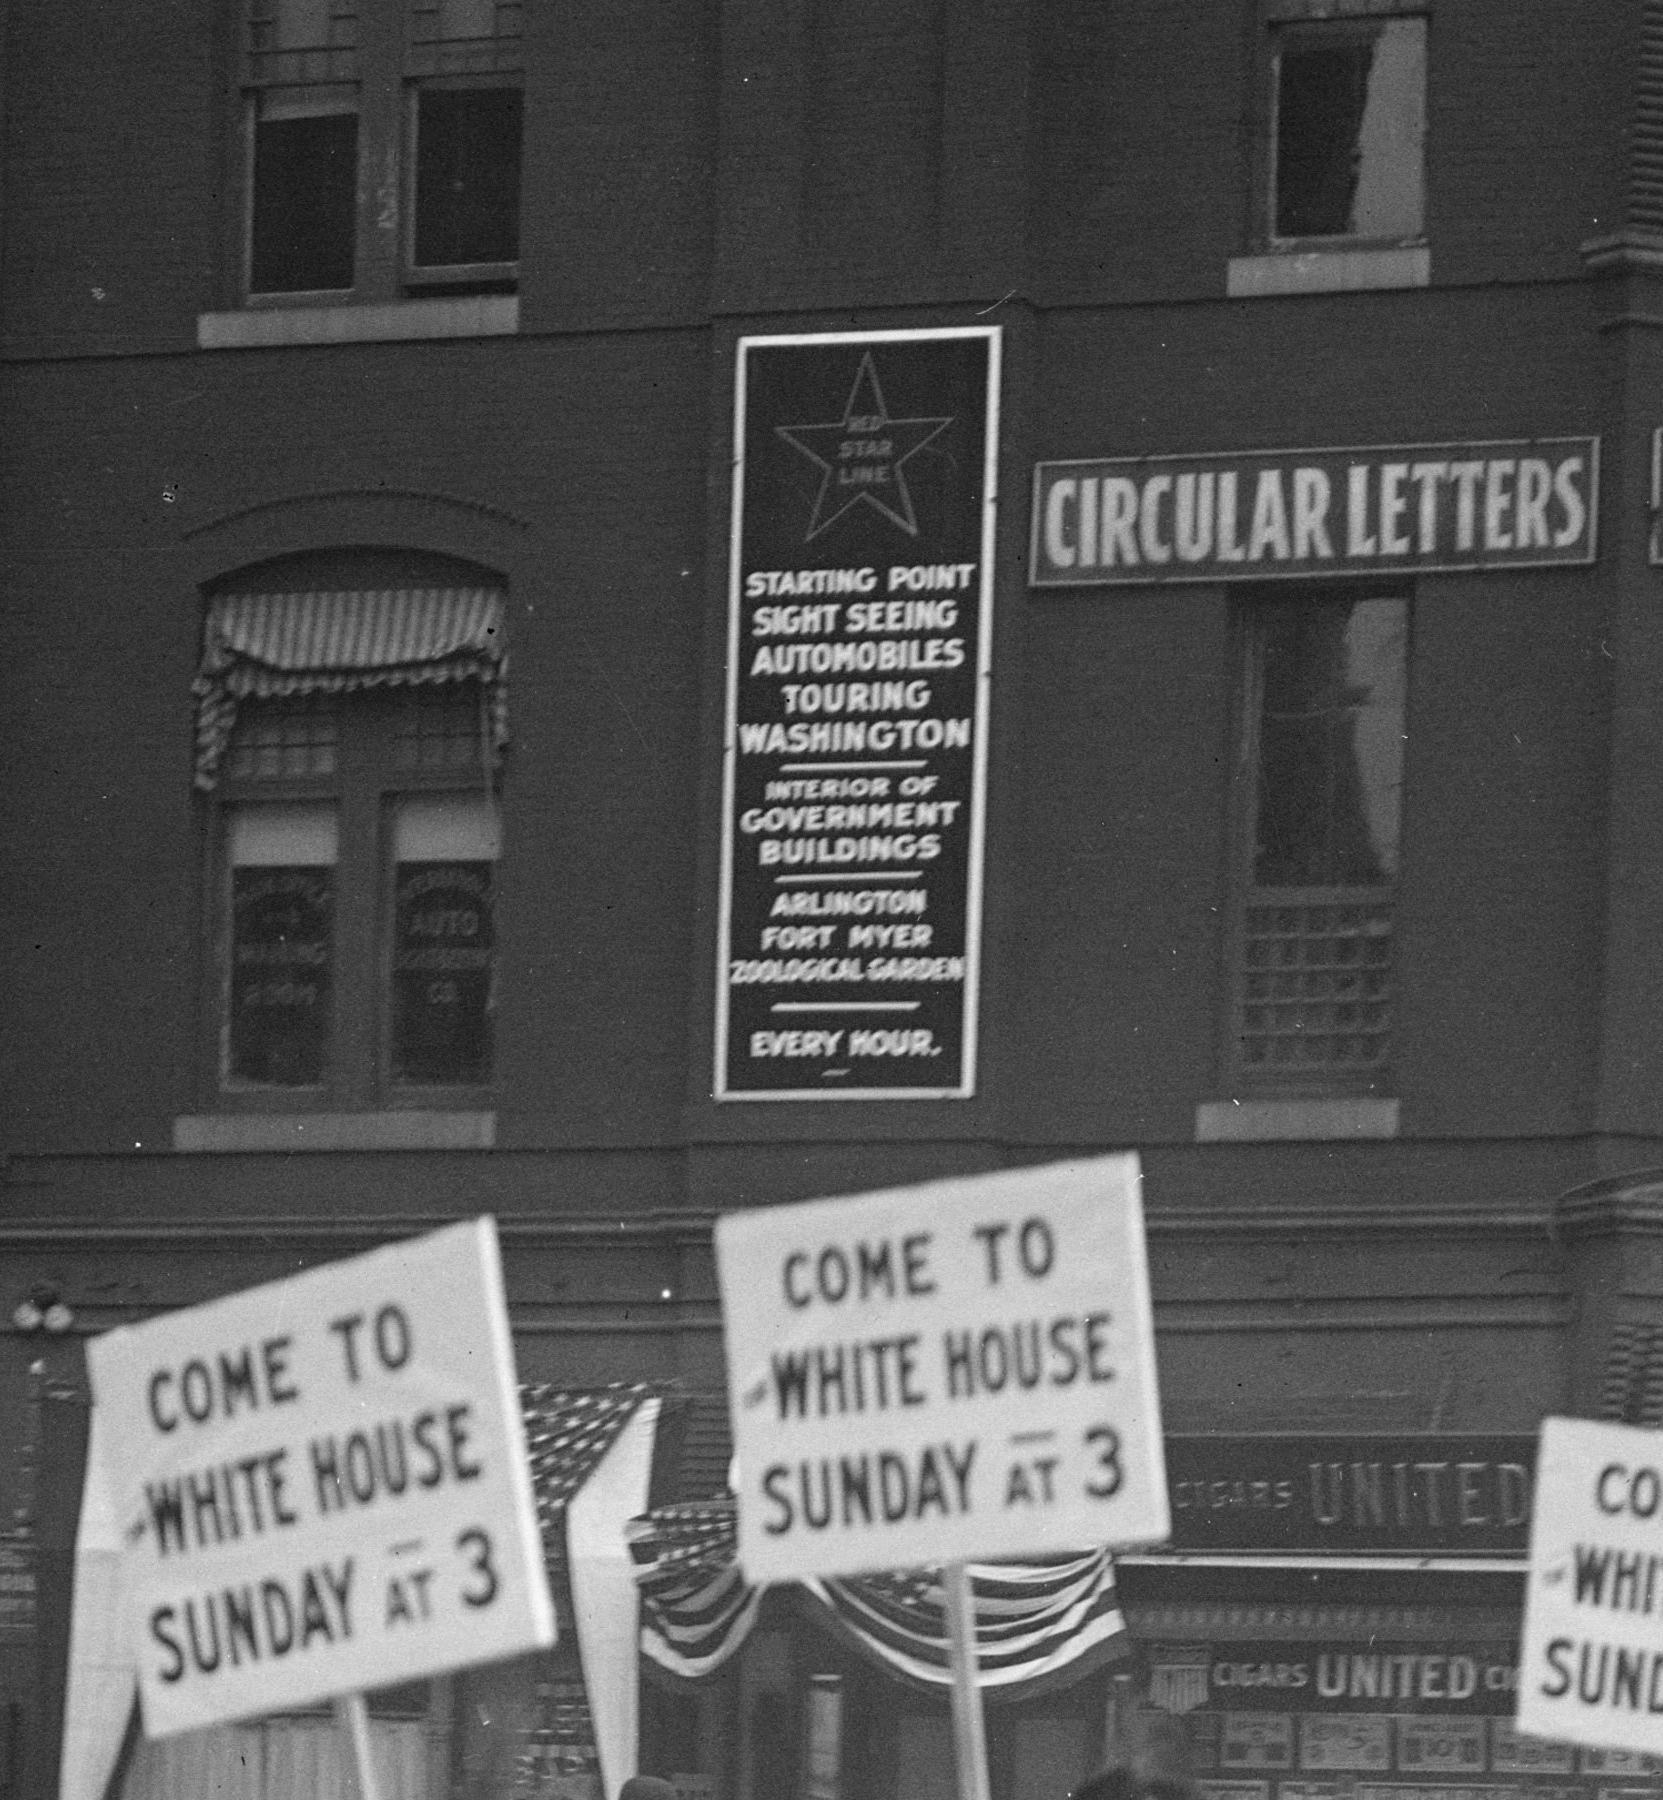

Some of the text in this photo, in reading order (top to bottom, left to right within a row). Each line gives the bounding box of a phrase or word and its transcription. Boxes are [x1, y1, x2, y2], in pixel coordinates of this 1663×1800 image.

[838, 466, 889, 485] LINE
[1045, 456, 1586, 568] CIRCULAR LETTERS
[745, 563, 977, 597] STARTING POINT
[751, 599, 960, 636] SIGHT SEEING
[750, 637, 966, 676] AUTOMOBILES
[781, 679, 933, 714] TOURING
[739, 718, 972, 755] WASHINGTON
[765, 775, 939, 801] INTERIOR OF
[739, 801, 961, 833] GOVERNMENT
[758, 833, 942, 865] BUILDINGS
[769, 888, 928, 917] ARLINGTON
[408, 909, 480, 937] AUTO
[761, 923, 933, 950] FORT MYER
[730, 956, 966, 984] ZOOLOGICAL GARDEN
[750, 1029, 943, 1057] EVERY HOUR.
[781, 1216, 1056, 1311] COME TO
[147, 1304, 414, 1434] COME TO
[770, 1311, 1116, 1421] WHITE HOUSE
[145, 1403, 483, 1558] WHITE HOUSE
[761, 1425, 1126, 1538] SUNDAY AT 3
[1307, 1462, 1529, 1527] UNITED
[149, 1526, 501, 1684] SUNDAY AT 3
[1212, 1662, 1309, 1689] CIGARS
[1315, 1653, 1478, 1699] UNITED
